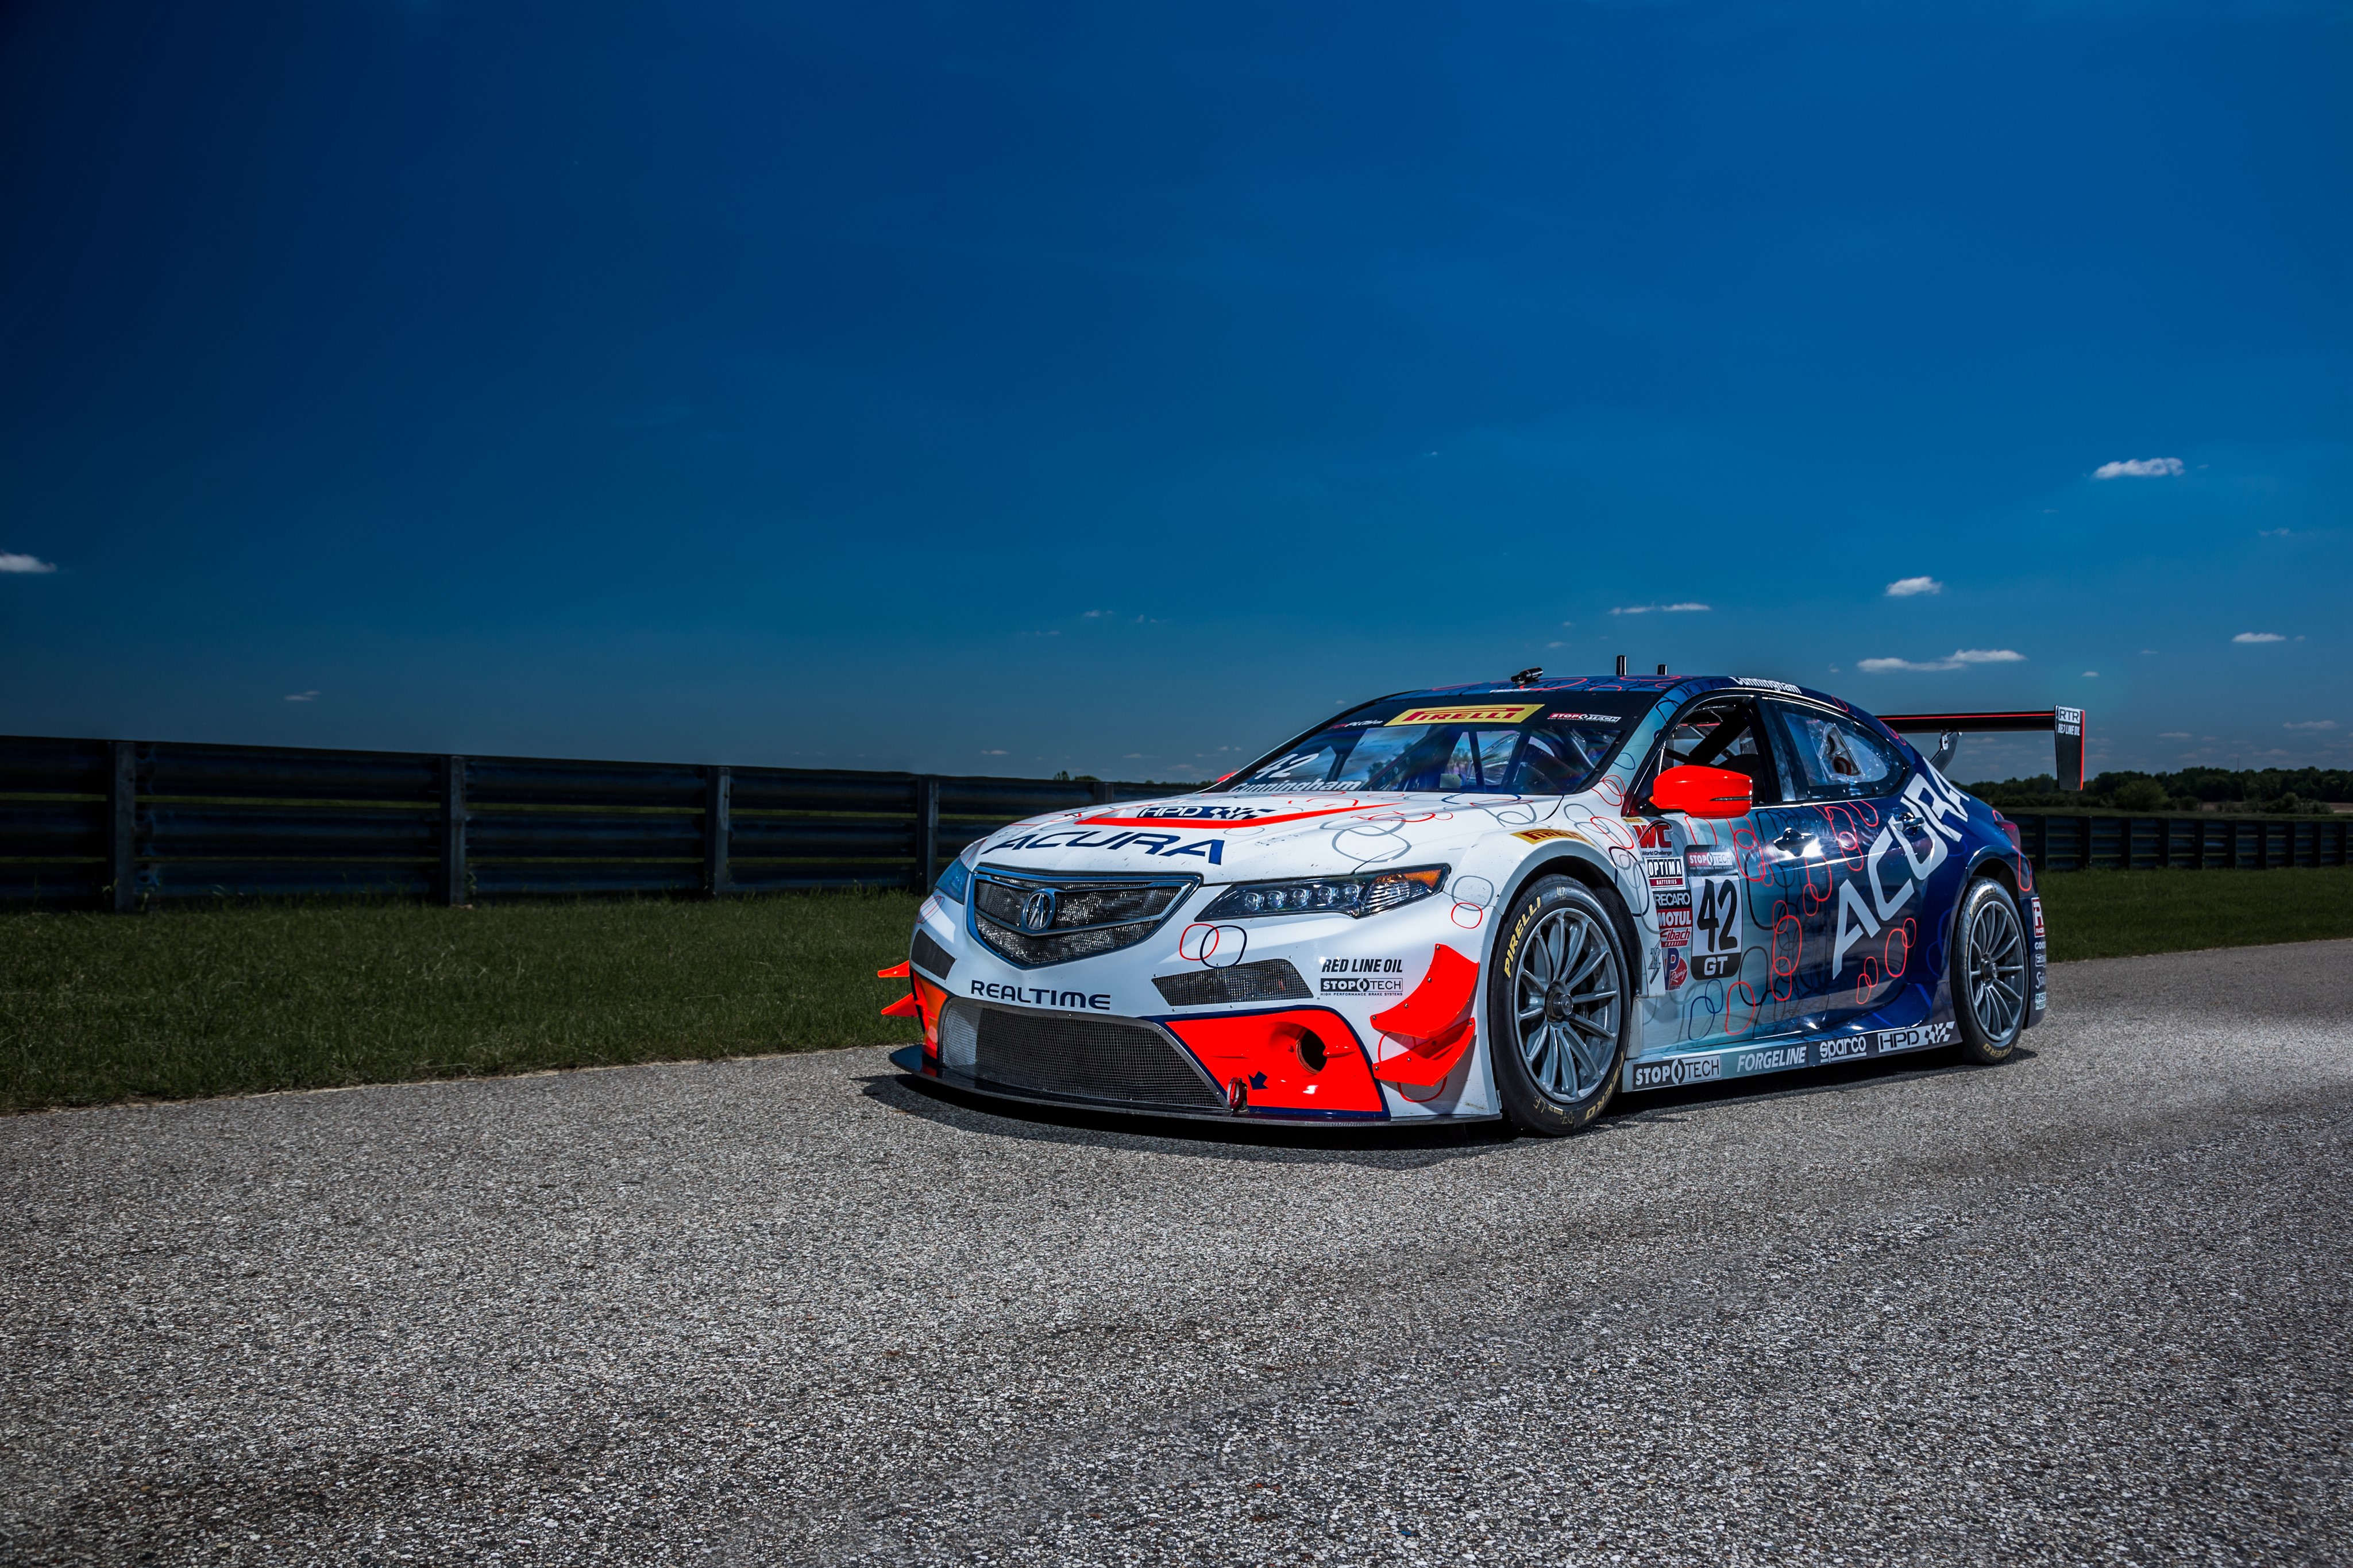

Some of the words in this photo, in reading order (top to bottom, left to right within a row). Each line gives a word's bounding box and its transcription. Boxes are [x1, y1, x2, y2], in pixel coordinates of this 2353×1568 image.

[1402, 707, 1525, 722] PIRELLI
[2059, 708, 2079, 721] RTR
[1254, 753, 1320, 780] 42
[1228, 778, 1362, 793] Cunningham
[1139, 806, 1203, 817] HPD
[1632, 824, 1672, 848] WC
[981, 831, 1225, 866] ACURA
[1648, 860, 1681, 876] OPTIMA
[1833, 756, 1970, 980] ACURA
[1654, 892, 1691, 906] RECARO
[1657, 910, 1692, 926] MOTUL
[1697, 879, 1738, 953] 42
[1505, 896, 1541, 979] PIRELLI
[1660, 928, 1691, 941] Eibach
[1321, 959, 1349, 972] RED
[1351, 959, 1382, 972] LINE
[1383, 959, 1403, 972] OIL
[1704, 956, 1728, 976] GT
[971, 979, 1111, 1010] REALTIME
[1820, 1036, 1867, 1063] sparco
[1880, 1030, 1920, 1050] HPD
[1737, 1046, 1807, 1073] FORGELINE
